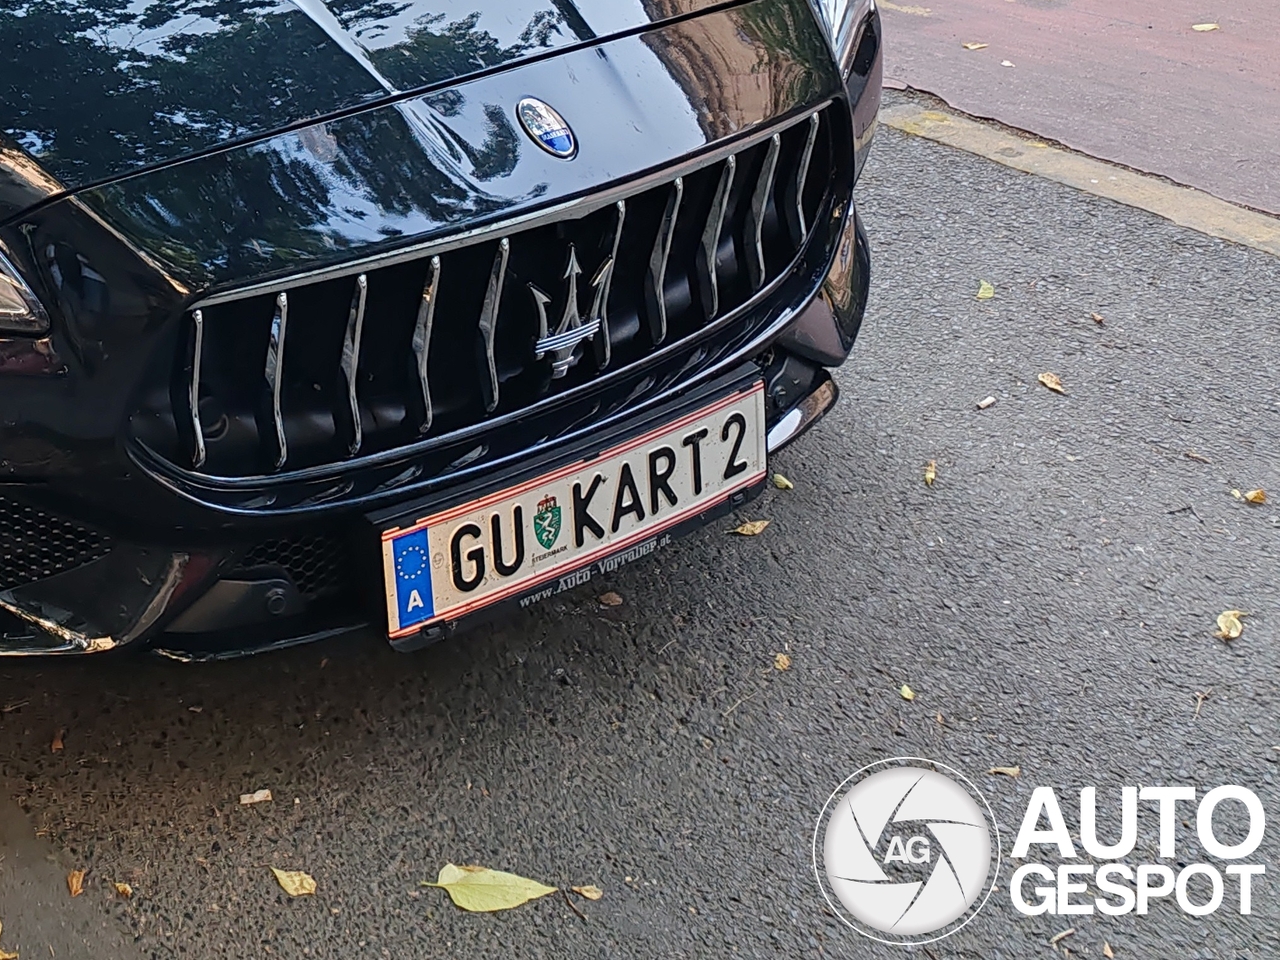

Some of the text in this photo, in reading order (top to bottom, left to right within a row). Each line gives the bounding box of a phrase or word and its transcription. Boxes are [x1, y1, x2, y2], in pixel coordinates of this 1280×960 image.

[450, 412, 748, 593] GU KART 2
[532, 544, 569, 563] STEIERMARK
[407, 589, 424, 613] A
